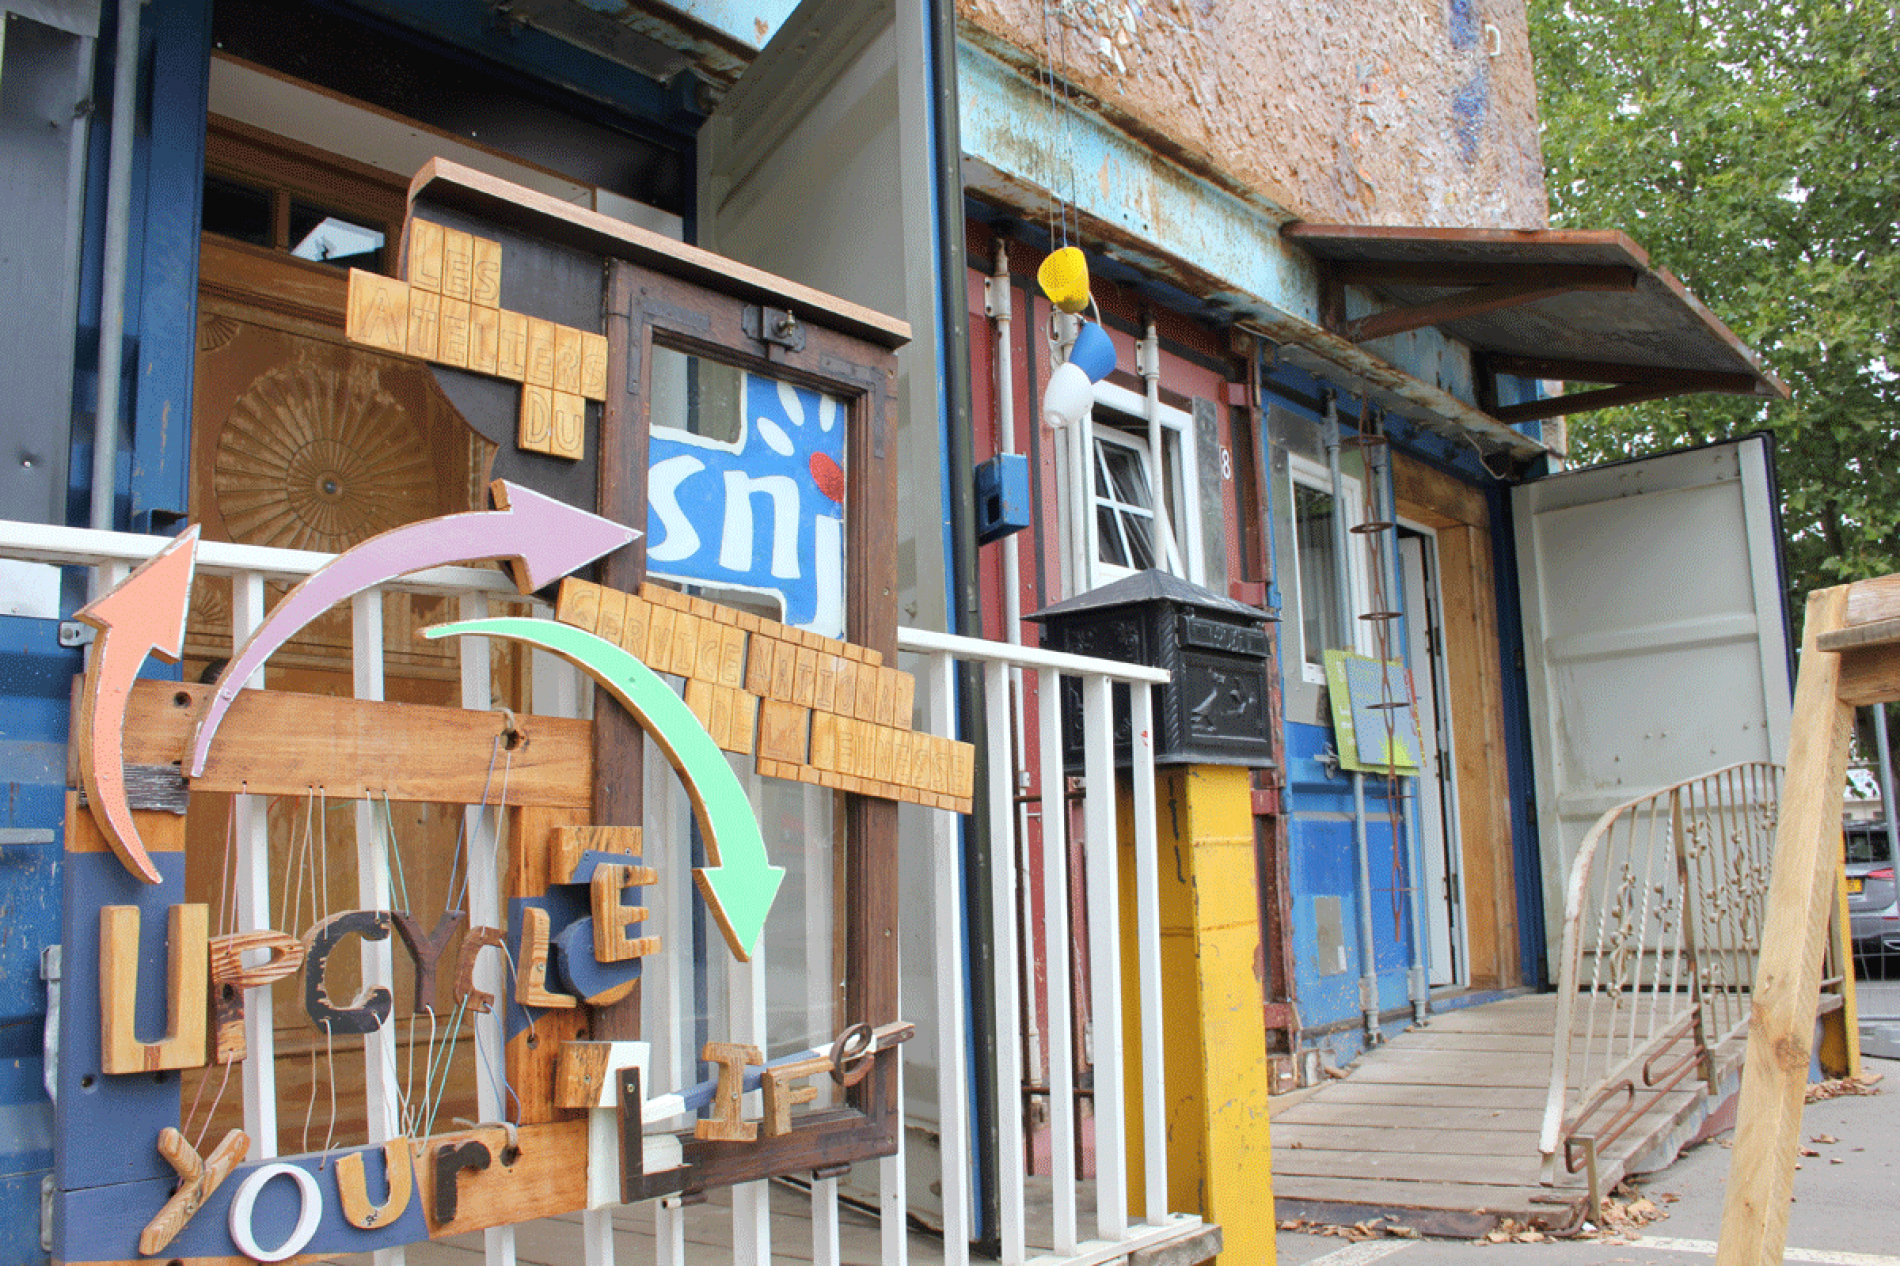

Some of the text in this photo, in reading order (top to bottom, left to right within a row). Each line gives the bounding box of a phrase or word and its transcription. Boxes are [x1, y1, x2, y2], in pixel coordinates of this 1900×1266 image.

[414, 228, 499, 301] LES
[362, 287, 604, 394] ATELIERS
[526, 389, 581, 451] DU
[1221, 448, 1231, 480] 8
[571, 589, 911, 729] SERVICE NATIONAL
[763, 713, 803, 760] LA
[815, 719, 965, 793] JEUNESSE
